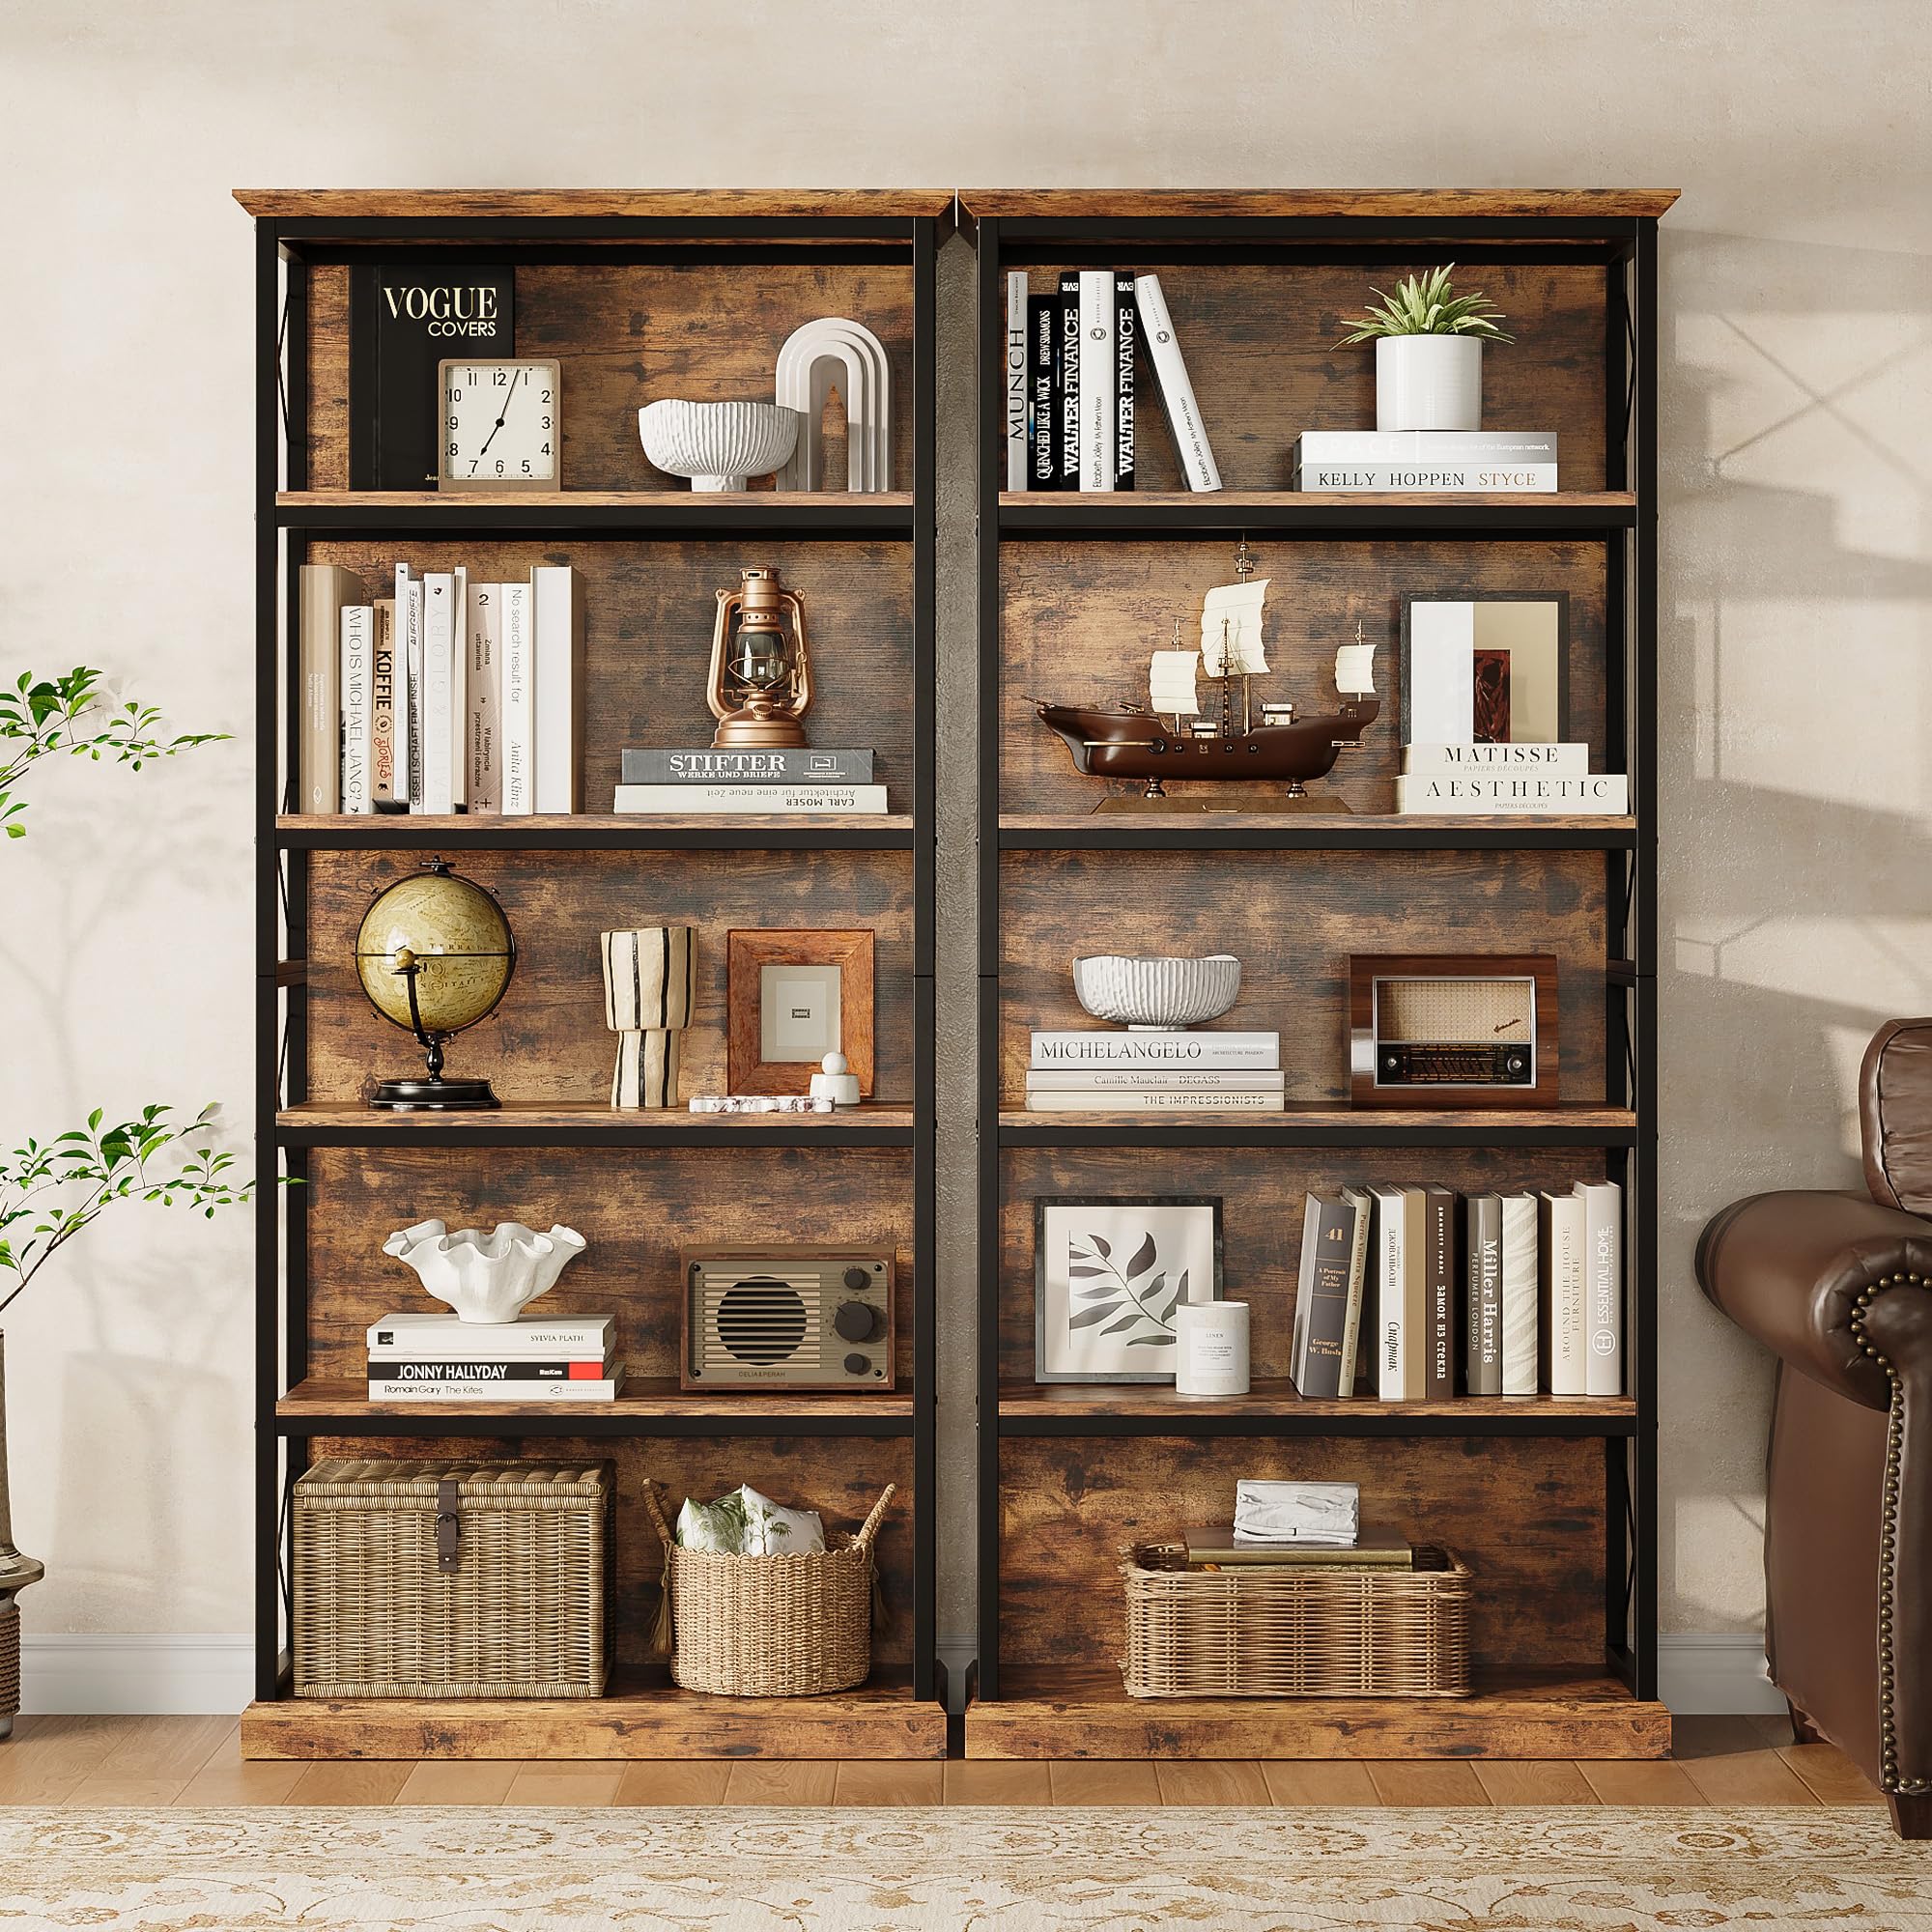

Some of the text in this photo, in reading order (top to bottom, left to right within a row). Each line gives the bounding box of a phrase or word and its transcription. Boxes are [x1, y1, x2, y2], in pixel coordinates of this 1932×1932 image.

[384, 287, 497, 320] VOGUE
[427, 321, 497, 337] COVERS
[468, 372, 477, 386] 11
[493, 372, 506, 386] 12
[524, 372, 528, 385] 1
[1009, 328, 1025, 441] MUNCH
[448, 388, 462, 403] 10
[1037, 376, 1051, 401] WICK
[1064, 308, 1079, 476] WALTER FINANCE
[1120, 308, 1134, 476] WALTER FINANCE
[541, 389, 551, 403] 2
[1037, 402, 1051, 411] A
[449, 415, 459, 430] 9
[541, 416, 551, 430] 3
[1037, 412, 1051, 429] LIKE
[449, 442, 459, 456] 8
[541, 442, 551, 455] 4
[469, 460, 478, 473] 7
[496, 459, 504, 473] 6
[521, 460, 530, 473] 5
[1319, 472, 1376, 487] KELLY
[1389, 472, 1464, 487] HOPPEN
[478, 593, 489, 606] 2
[511, 589, 523, 703] No search result for
[376, 650, 392, 710] KOFFIE
[349, 608, 362, 801] WHO IS MICHAEL JANG?
[1444, 748, 1558, 763] MATISSE
[669, 754, 786, 772] STIFTER
[1463, 764, 1496, 773] PAPIERS
[511, 741, 523, 808] Anita Klinz
[706, 789, 726, 798] Zeit
[729, 789, 753, 798] neue
[756, 789, 778, 798] eine
[799, 788, 856, 799] Architektur
[1427, 781, 1608, 798] AESTHETIC
[785, 798, 855, 807] CARL MOSER
[1040, 1041, 1202, 1059] MICHELANGELO
[1094, 1075, 1128, 1085] Camille
[1179, 1075, 1220, 1085] DEGASS
[1144, 1095, 1264, 1105] THE IMPRESSIONISTS
[1324, 1228, 1344, 1241] 41
[1322, 1267, 1347, 1276] Portrait
[1598, 1226, 1609, 1324] ESSENTIAL HOME
[1562, 1226, 1571, 1361] AROUND THE HOUSE
[1572, 1257, 1580, 1332] FURNITURE
[1483, 1239, 1497, 1364] Miller Harris
[1309, 1346, 1320, 1354] W.
[1312, 1338, 1339, 1348] George
[1385, 1321, 1401, 1372] Спартак
[397, 1365, 507, 1380] JONNY HALLYDAY
[384, 1384, 441, 1395] Romain Gary
[444, 1384, 483, 1394] The Kites
